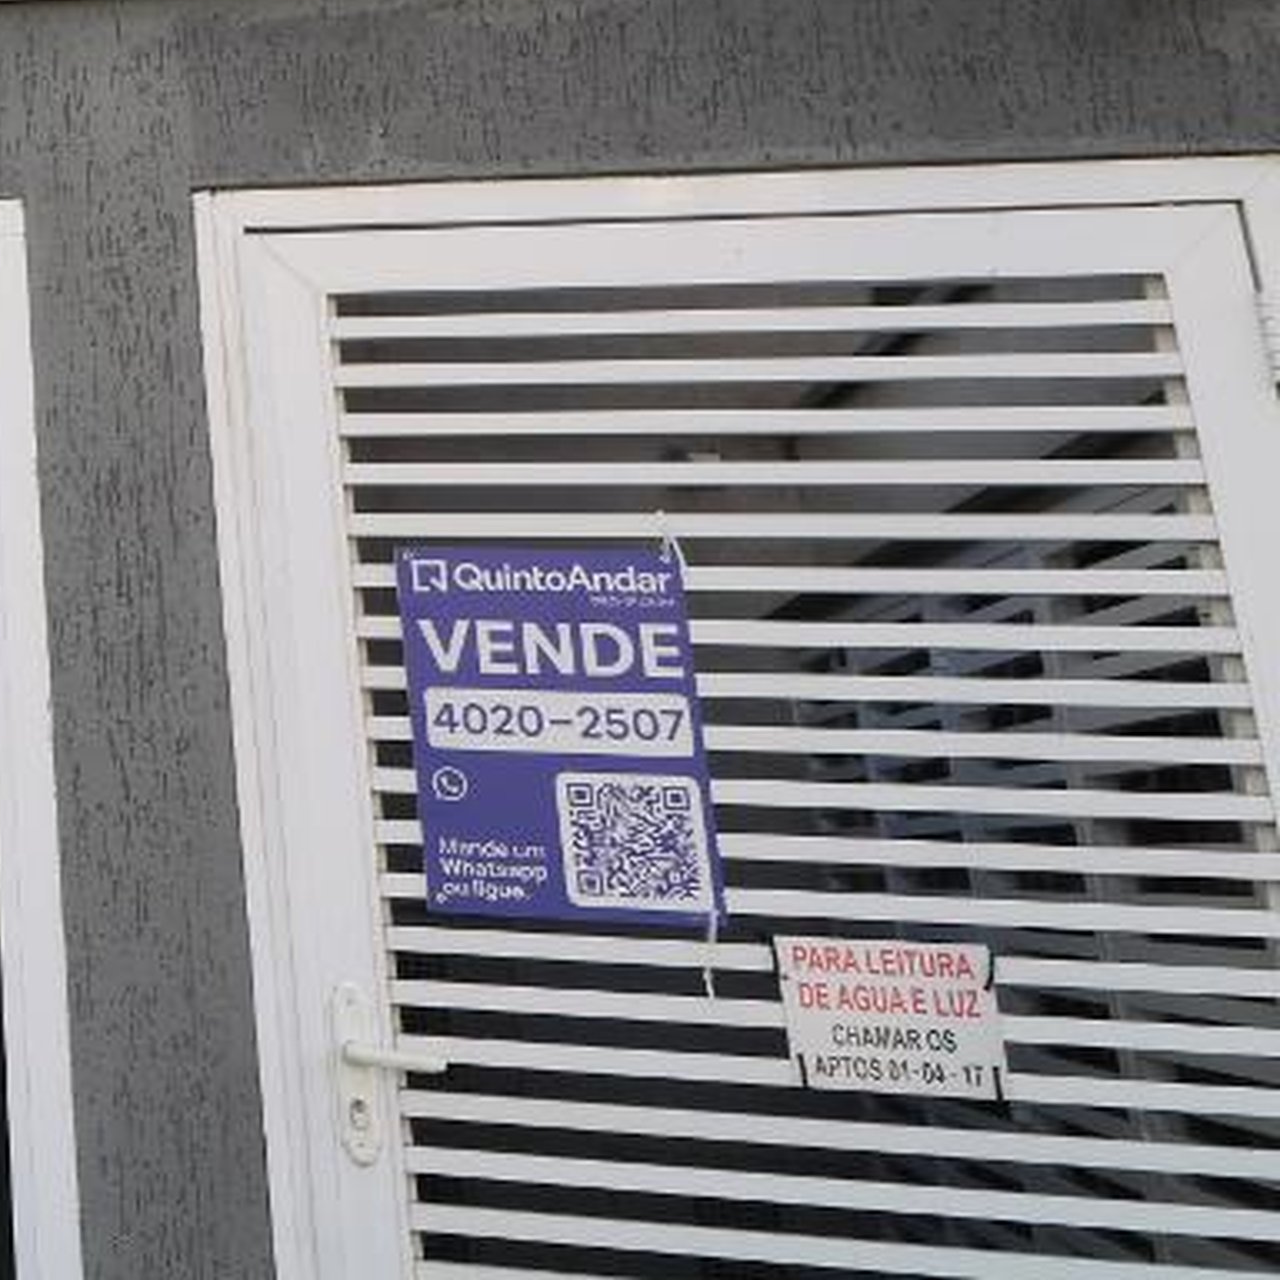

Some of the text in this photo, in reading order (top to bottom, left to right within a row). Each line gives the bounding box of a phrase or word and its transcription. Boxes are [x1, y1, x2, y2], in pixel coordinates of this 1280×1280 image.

[453, 562, 672, 593] QuintoAndar
[417, 619, 685, 678] VENDE
[433, 702, 686, 741] 4020-2507
[792, 945, 975, 980] PARA LEITURA
[798, 982, 982, 1019] DE AGUA E LUZ
[831, 1024, 959, 1054] CHAMAR OS
[813, 1055, 883, 1082] APTOS
